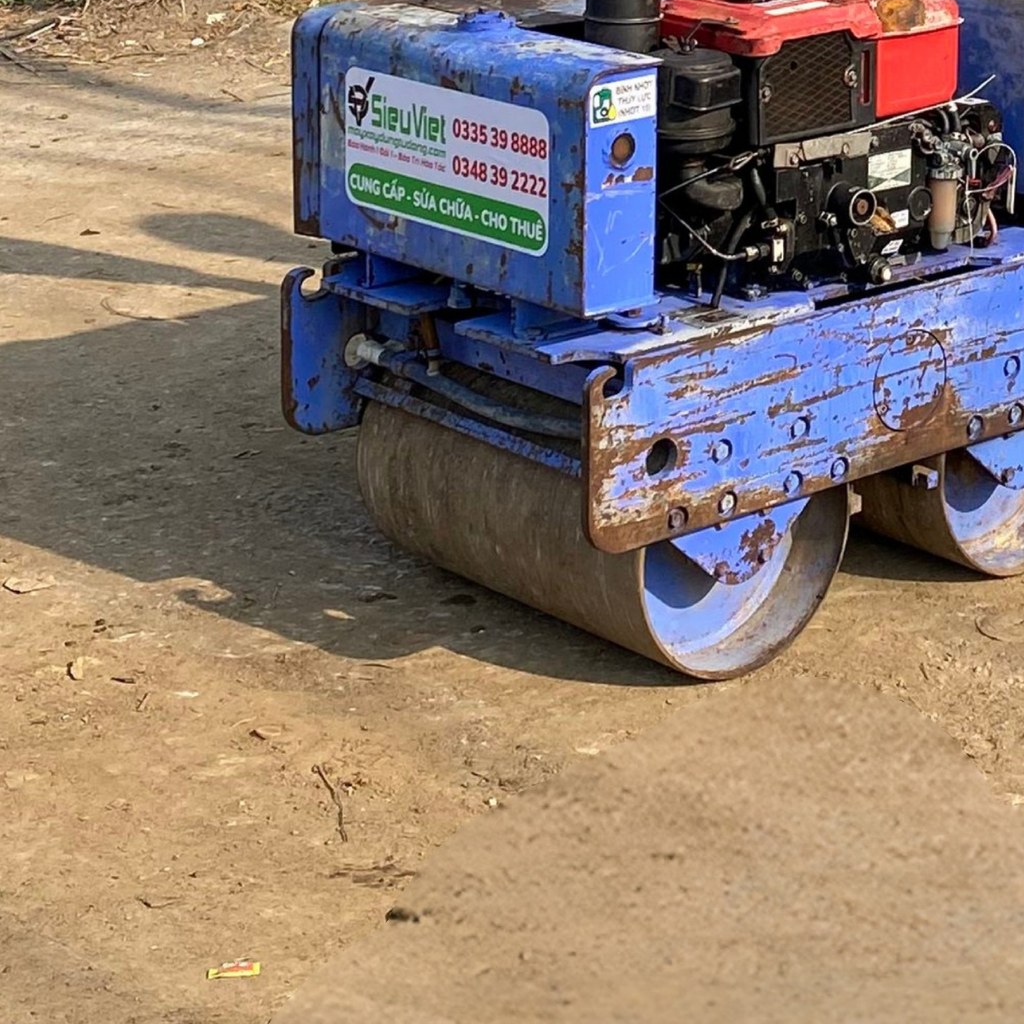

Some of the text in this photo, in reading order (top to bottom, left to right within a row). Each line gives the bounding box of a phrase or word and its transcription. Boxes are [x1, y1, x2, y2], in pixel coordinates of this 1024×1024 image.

[371, 94, 447, 145] SieuViet
[452, 118, 547, 160] 0335 39 8888
[452, 155, 547, 198] 0348 39 2222
[350, 173, 381, 196] CUNG
[382, 178, 406, 202] CẤP
[413, 188, 437, 212] SỬA
[439, 197, 473, 222] CHỮA
[481, 209, 508, 231] CHO
[509, 219, 543, 241] THUÊ
